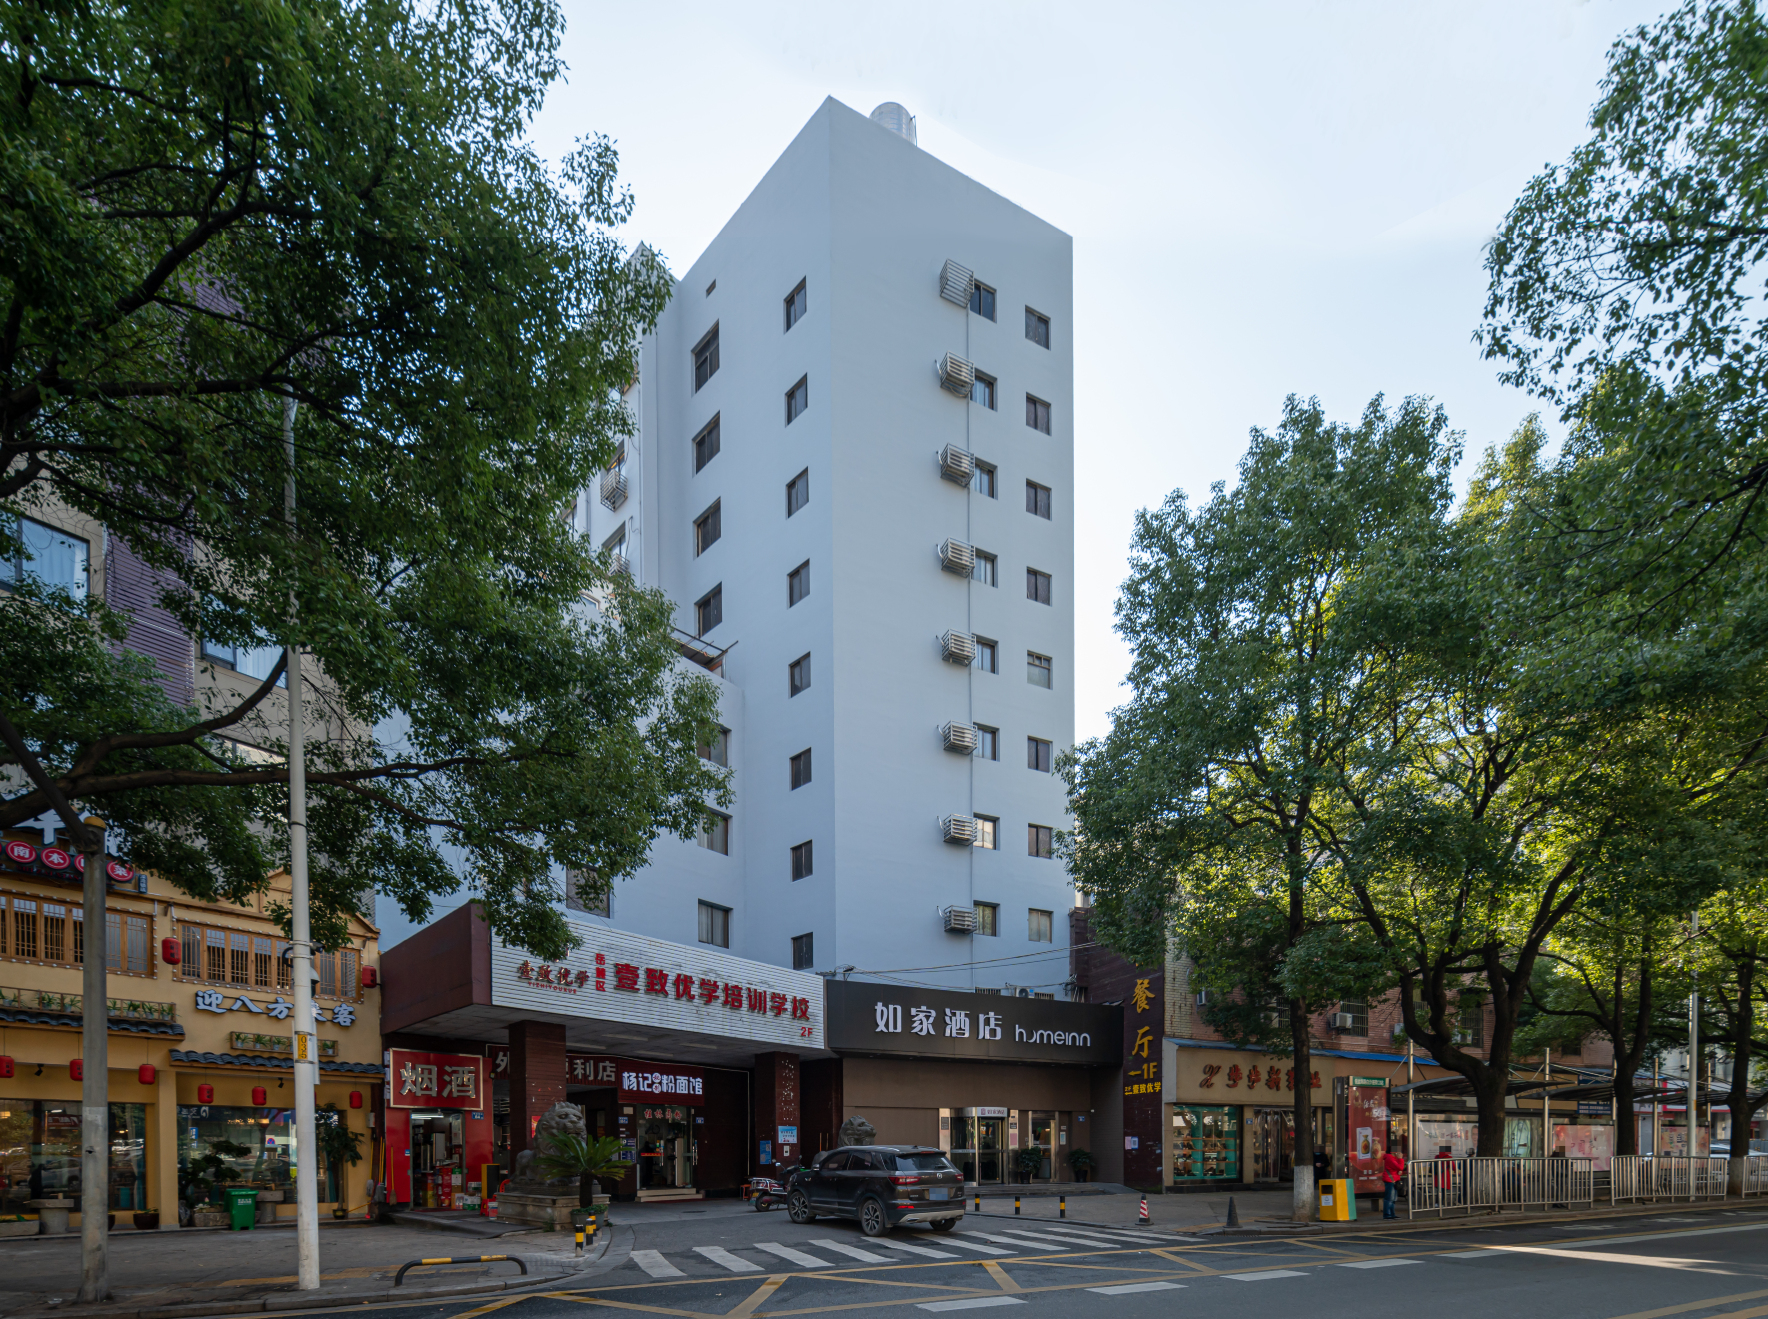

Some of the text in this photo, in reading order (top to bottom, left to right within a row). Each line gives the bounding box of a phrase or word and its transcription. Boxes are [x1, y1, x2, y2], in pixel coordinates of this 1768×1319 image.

[14, 845, 129, 877] 南本菜
[614, 963, 810, 1021] 壹致优学培训学校
[801, 1026, 813, 1038] 2F
[875, 1001, 1003, 1041] 如家酒店
[1131, 979, 1156, 1058] 餐厅
[400, 1062, 476, 1098] 烟酒
[1142, 1062, 1158, 1079] 1F
[1132, 1082, 1162, 1094] 壹致优学
